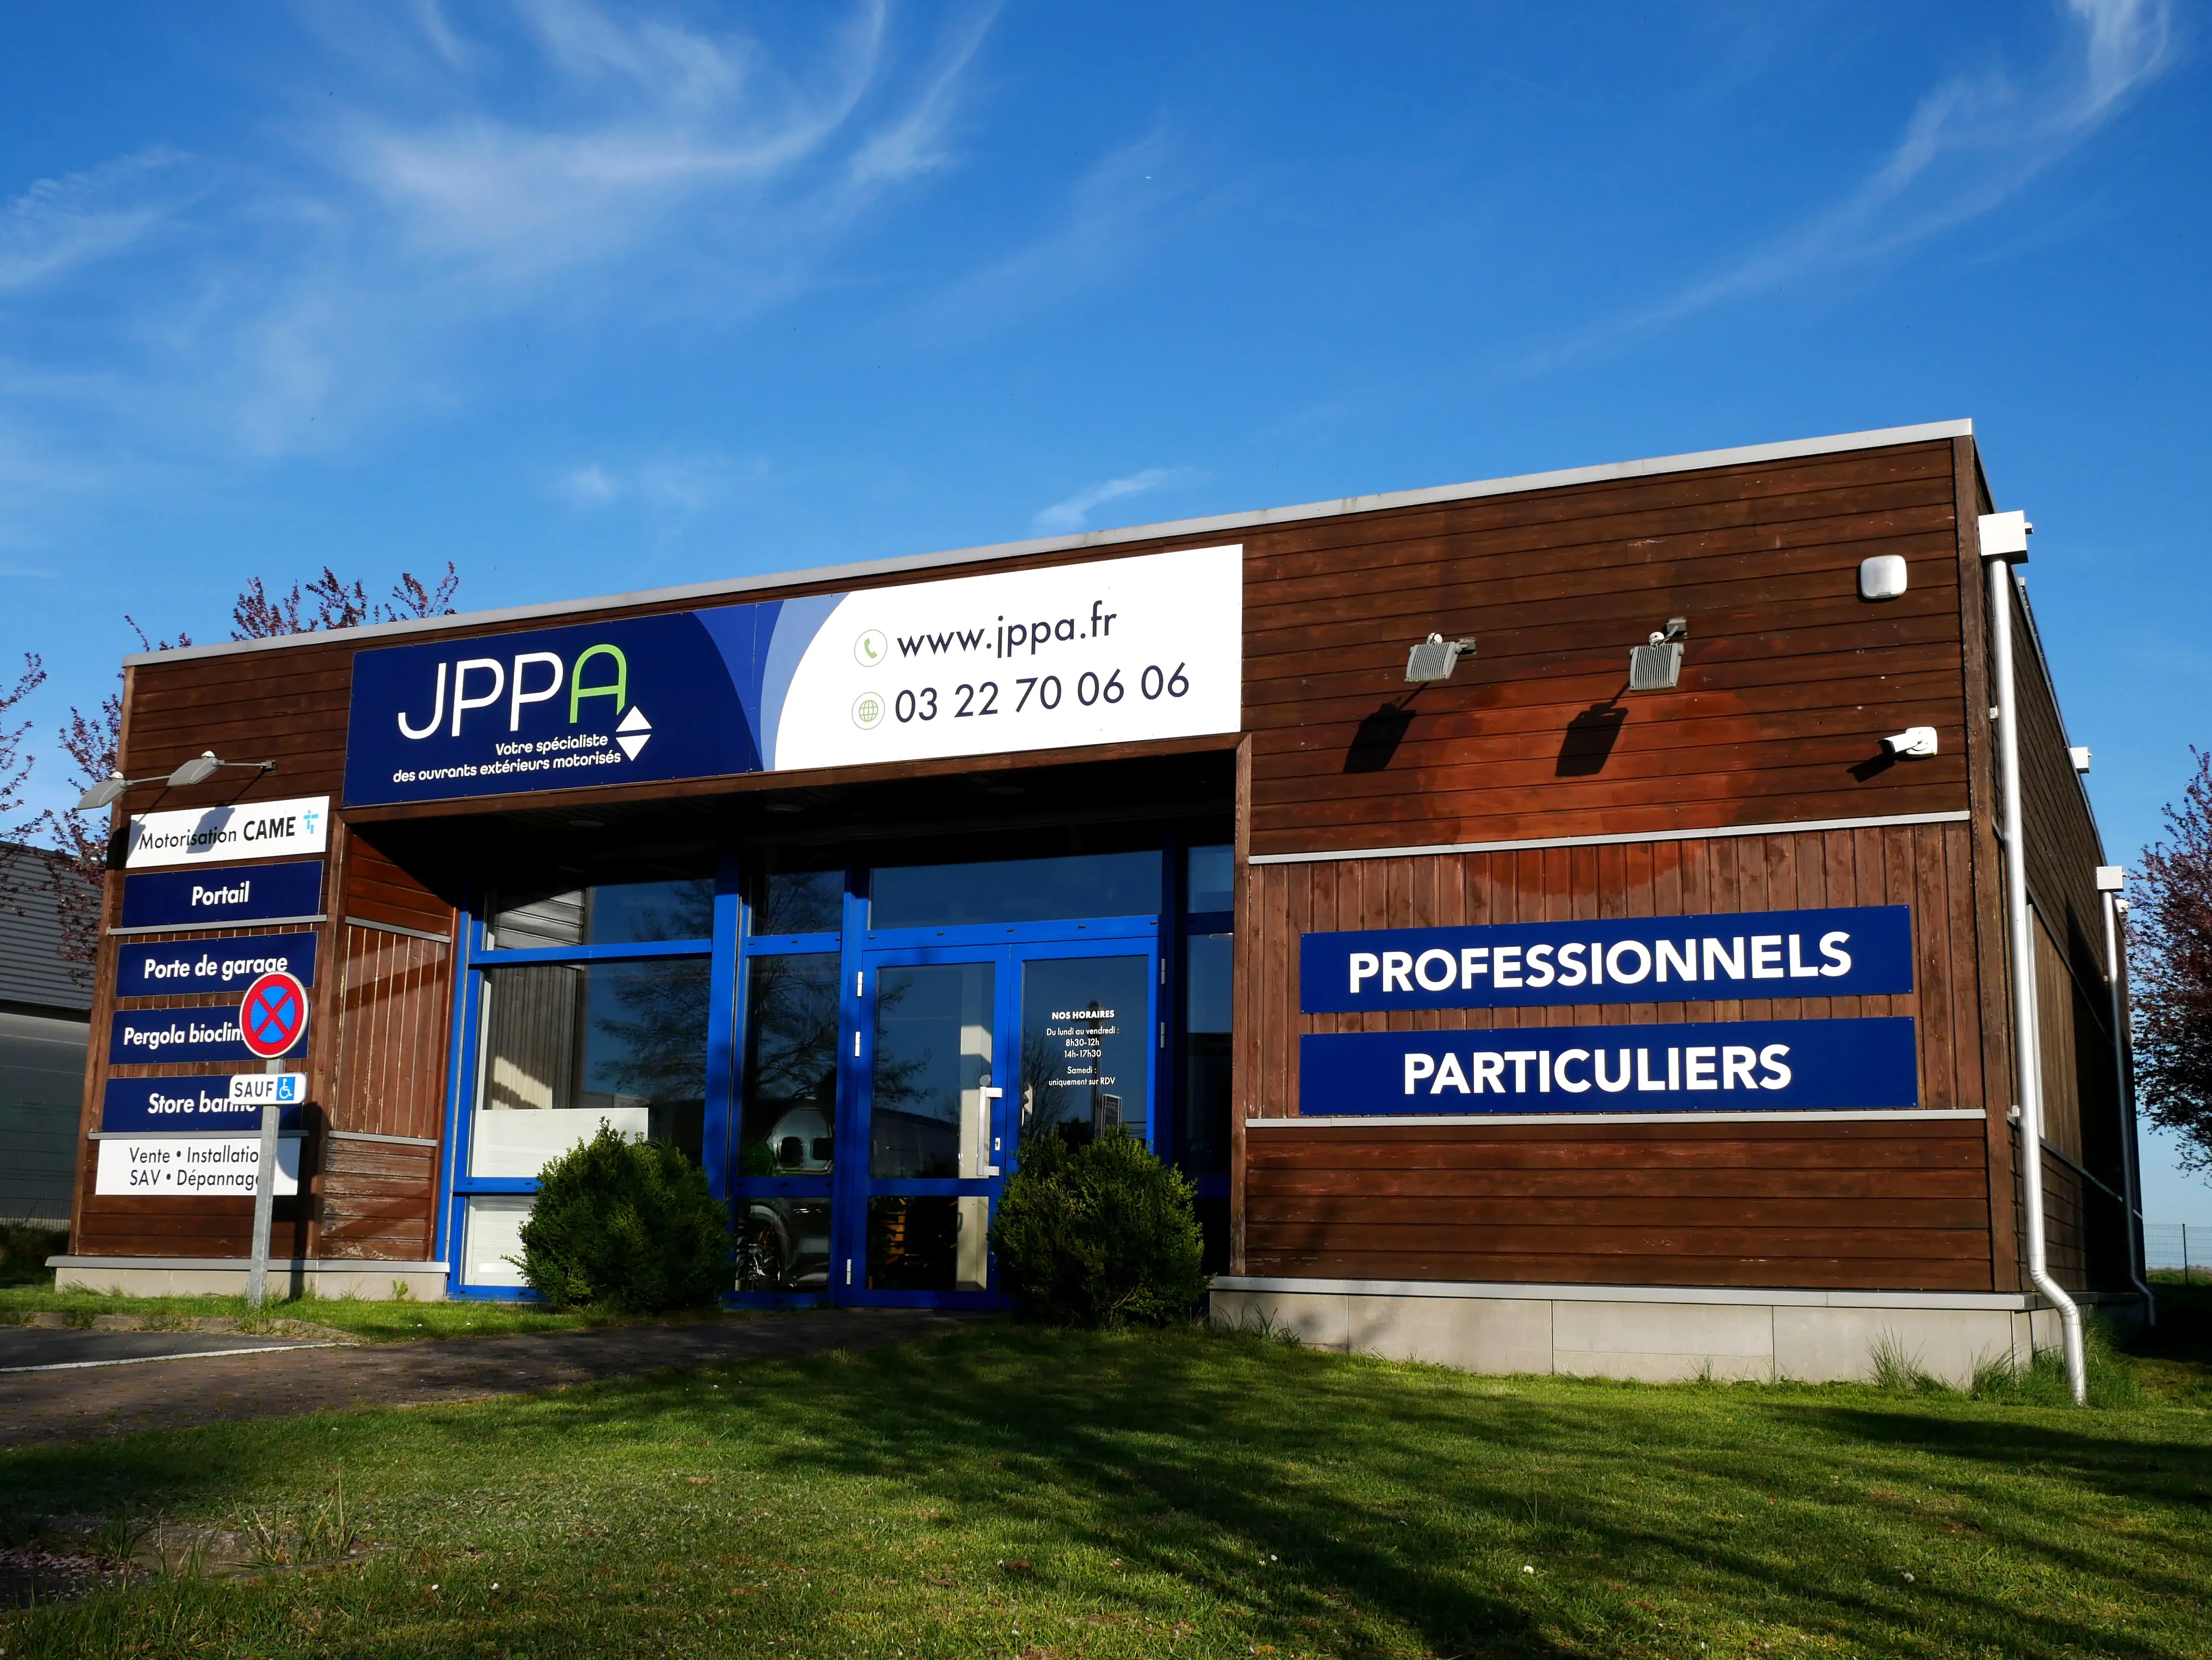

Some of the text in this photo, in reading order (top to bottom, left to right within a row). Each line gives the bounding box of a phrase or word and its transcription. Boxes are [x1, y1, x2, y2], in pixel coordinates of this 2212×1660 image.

[897, 600, 1117, 658] www.jppa.fr
[398, 644, 627, 740] JPPA
[896, 662, 1189, 723] 03 22 70 06 06
[496, 734, 608, 756] Votre spécialiste
[393, 752, 621, 782] des ouvrants extérieurs motorisés
[139, 816, 296, 850] Motorisation CAME
[192, 881, 249, 905] Portail
[145, 959, 190, 978] Porte
[195, 954, 217, 976] de
[1350, 932, 1851, 993] PROFESSIONNELS
[1072, 1010, 1114, 1019] HORAIRES
[124, 1022, 244, 1049] Pergola bioclim
[1058, 1027, 1074, 1035] lundi
[1086, 1026, 1115, 1034] vendredi
[1066, 1038, 1099, 1046] 8h30-12h
[1064, 1049, 1101, 1058] 14h-17h30
[1068, 1066, 1092, 1074] Samedi
[1405, 1045, 1791, 1094] PARTICULIERS
[235, 1081, 274, 1097] SAUF
[1049, 1079, 1087, 1087] uniquement
[148, 1093, 194, 1113] Store
[130, 1145, 258, 1163] Vente Installatio
[130, 1170, 160, 1185] SAV
